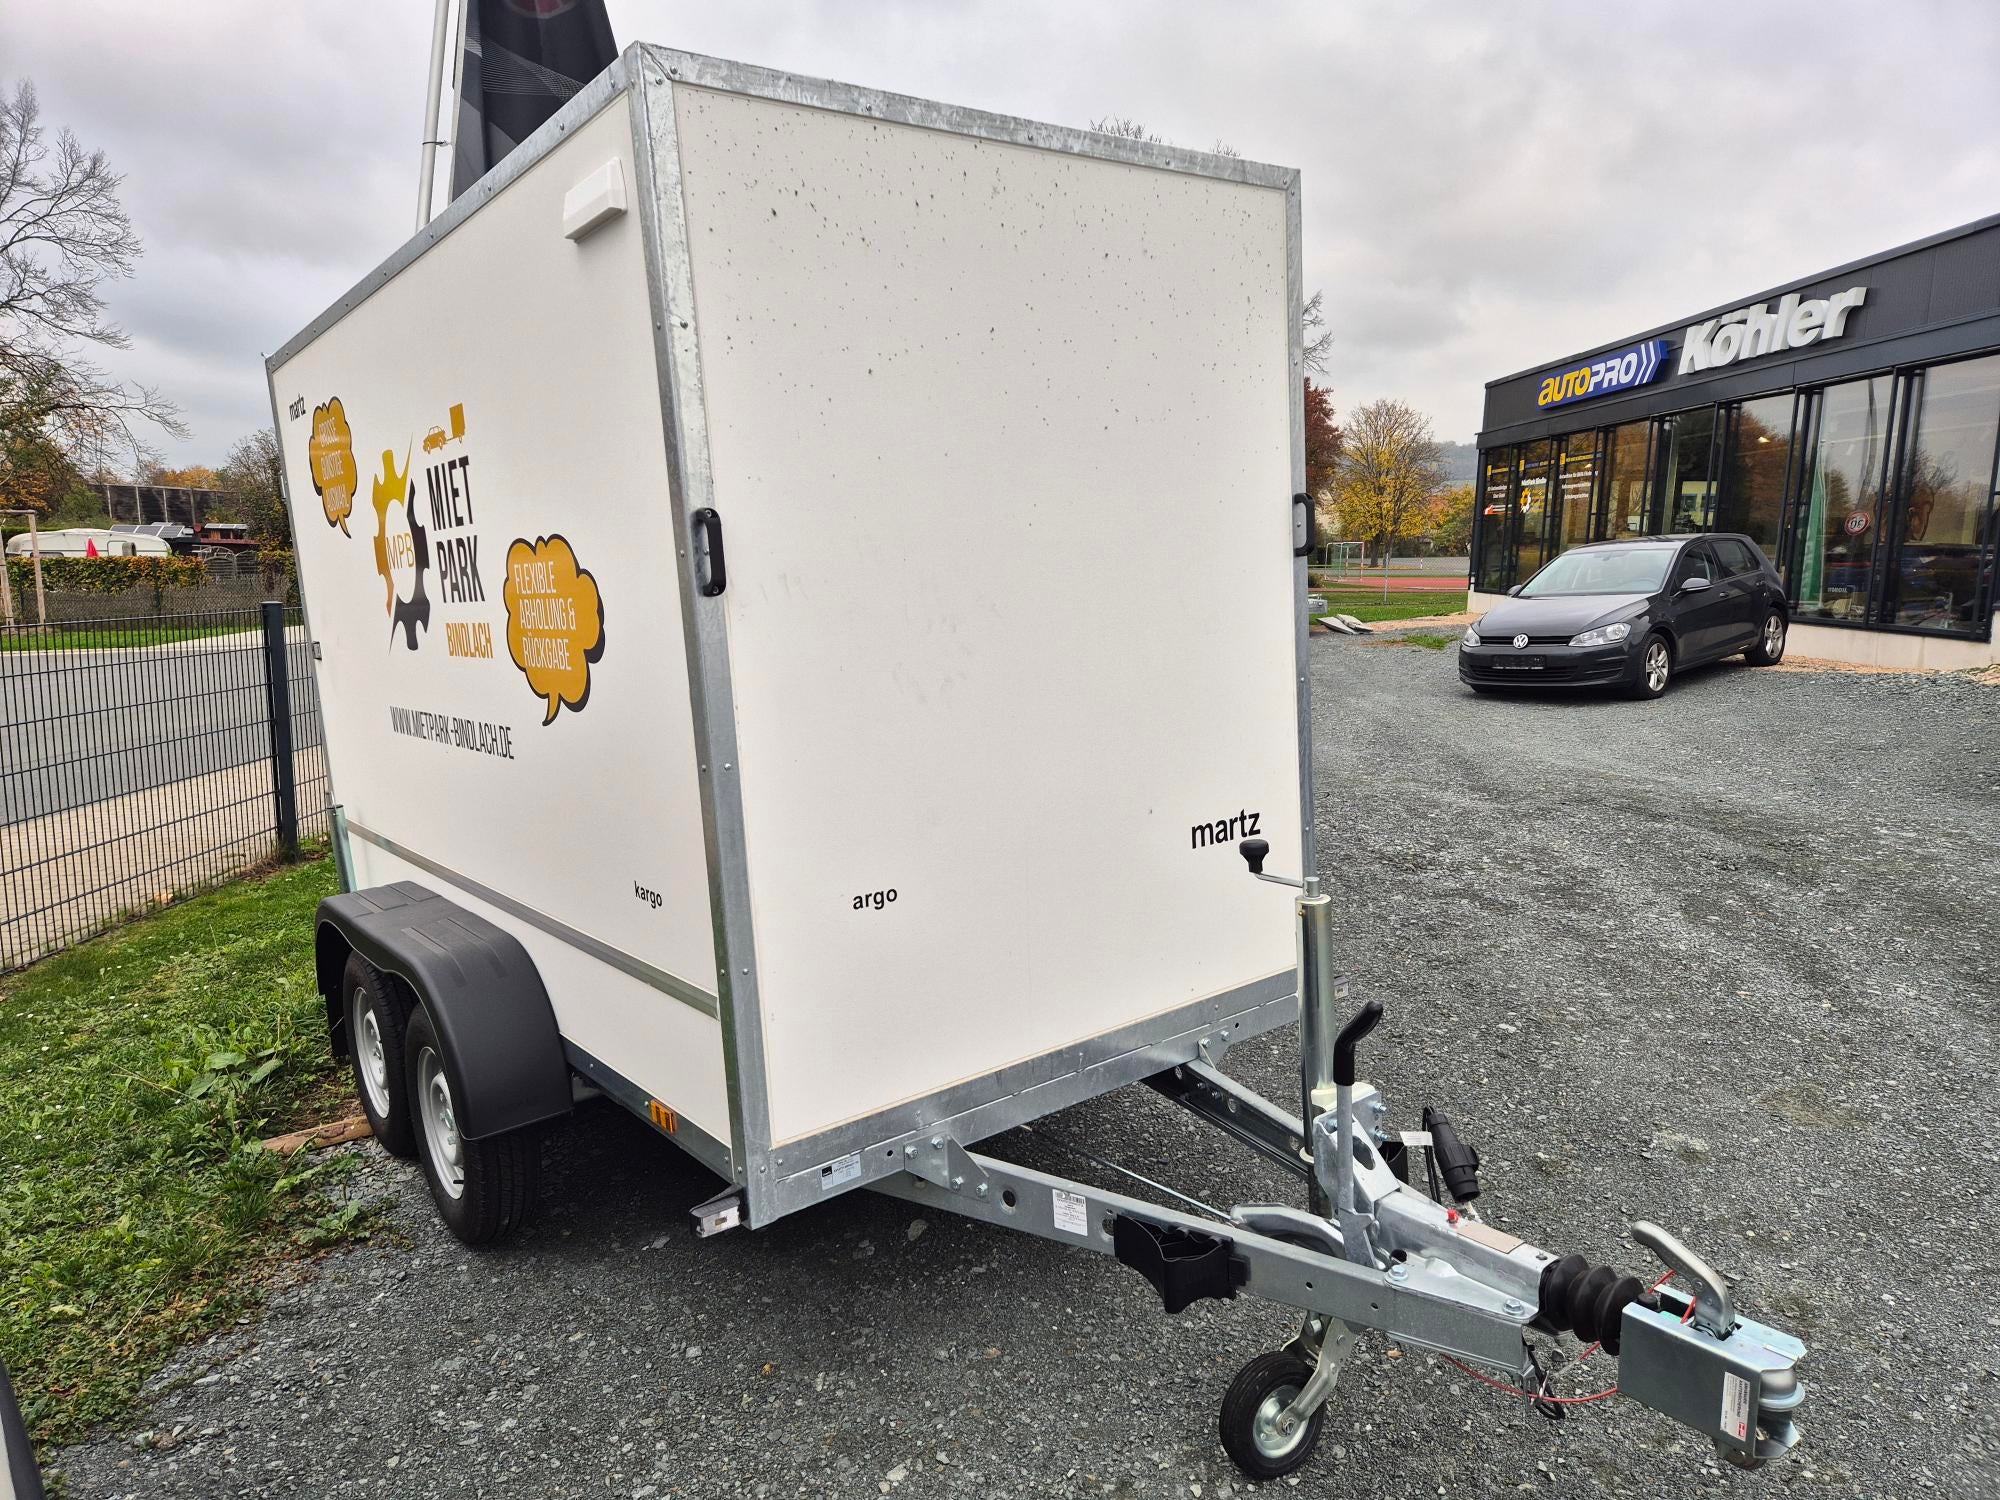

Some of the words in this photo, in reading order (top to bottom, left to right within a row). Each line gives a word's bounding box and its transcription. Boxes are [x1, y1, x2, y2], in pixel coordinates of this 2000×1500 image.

[1677, 287, 1868, 376] Köhler
[289, 394, 306, 422] martz
[426, 455, 474, 531] MIET
[386, 532, 415, 570] MPB
[436, 535, 485, 604] PARK
[513, 561, 557, 595] FLEXIBLE
[519, 597, 566, 631] ABHOLUNG
[567, 597, 576, 632] &
[445, 622, 494, 659] BINDLACH
[522, 631, 572, 671] RÜCKGABE
[389, 705, 515, 761] WWW.MIETPARK-BINDLACH.DE
[1191, 808, 1261, 850] martz
[634, 880, 663, 909] kargo
[852, 888, 898, 911] argo
